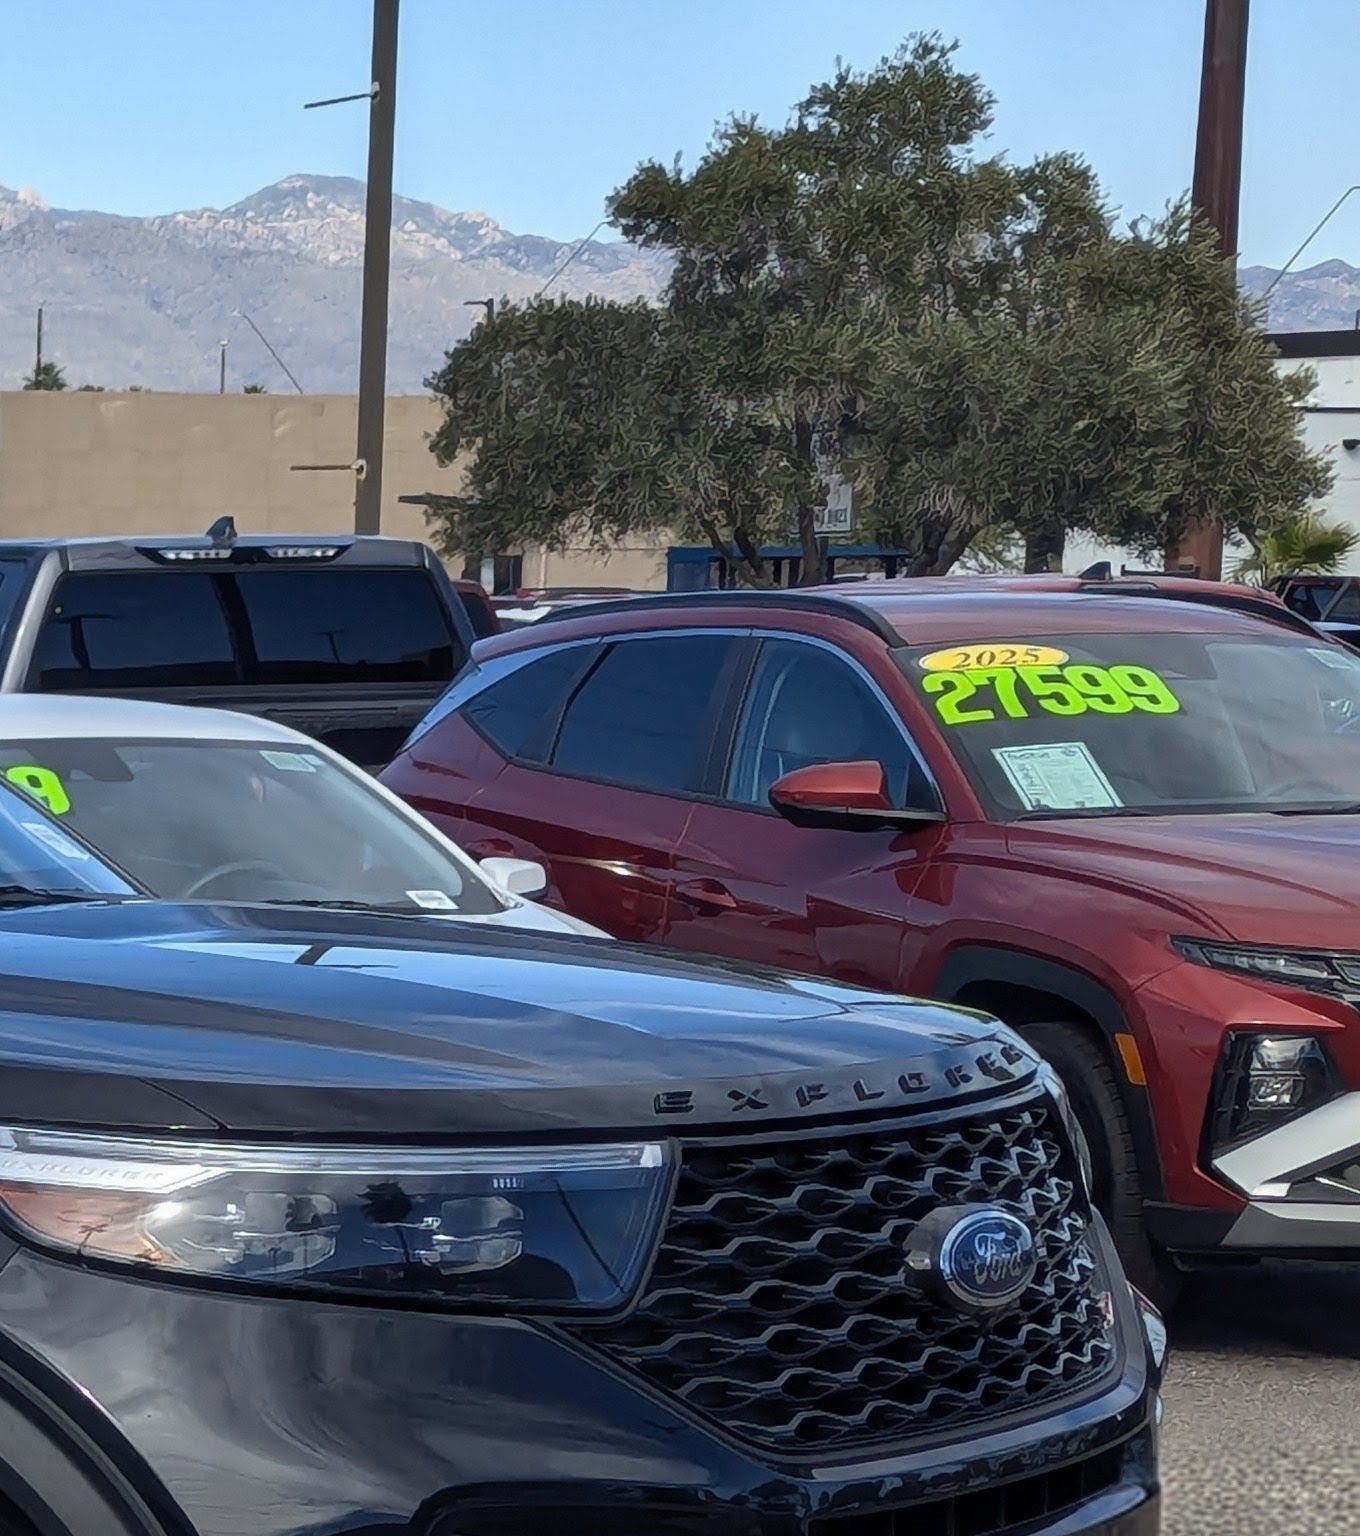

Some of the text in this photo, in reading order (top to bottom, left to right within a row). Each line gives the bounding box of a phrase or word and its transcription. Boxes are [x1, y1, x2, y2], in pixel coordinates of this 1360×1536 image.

[951, 648, 1042, 670] 2025
[920, 663, 1182, 726] 27599
[970, 1231, 1023, 1285] Ford
